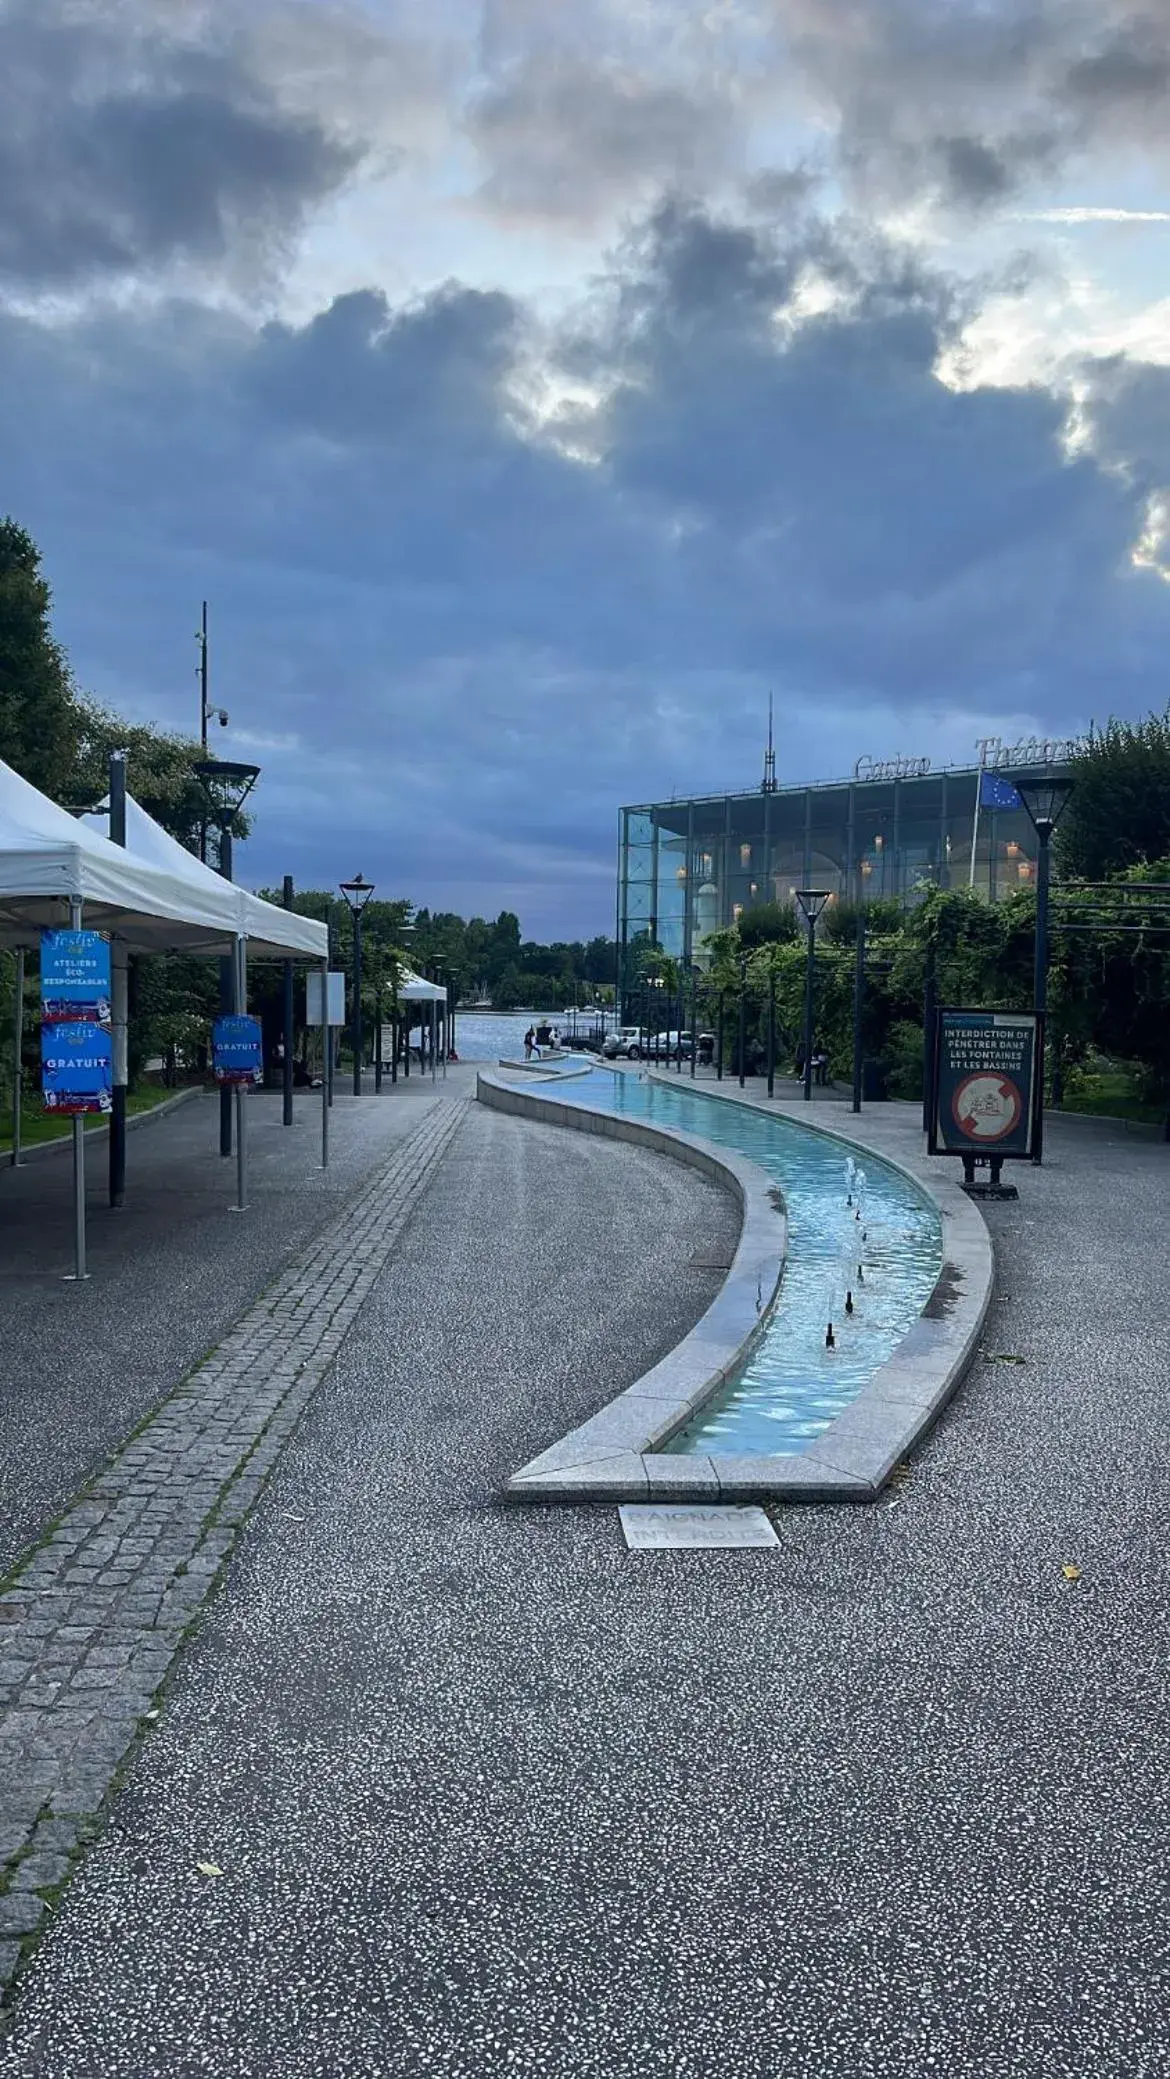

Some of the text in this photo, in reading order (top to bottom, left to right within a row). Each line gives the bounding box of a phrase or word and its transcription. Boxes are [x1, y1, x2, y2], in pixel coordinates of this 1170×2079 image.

[944, 1029, 1029, 1039] INTERDICTION DE
[948, 1039, 1025, 1050] PÉNÉTRER DANS
[950, 1051, 1022, 1060] LES FONTAINES
[47, 1058, 107, 1068] GRATUIT
[950, 1061, 961, 1069] ET
[983, 1062, 1021, 1071] BASSINS
[628, 1510, 759, 1523] BAIGNADE
[632, 1528, 769, 1542] INTERDITE
